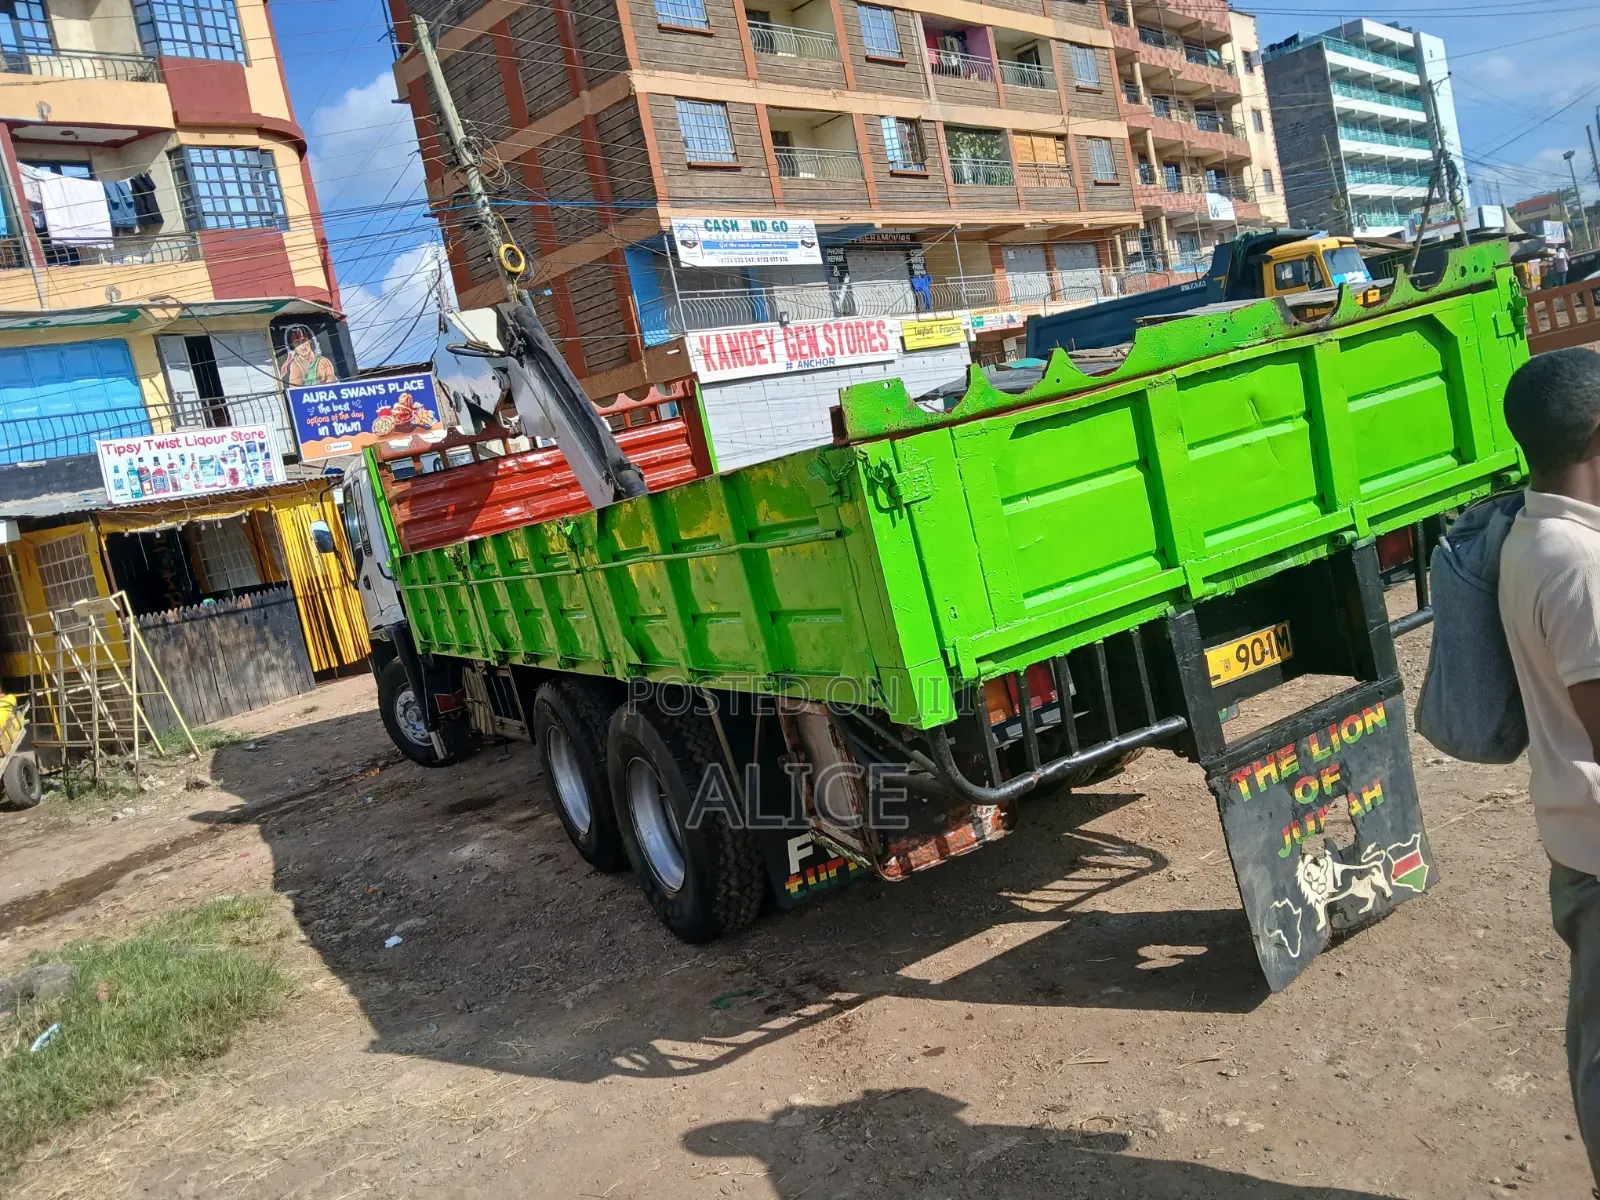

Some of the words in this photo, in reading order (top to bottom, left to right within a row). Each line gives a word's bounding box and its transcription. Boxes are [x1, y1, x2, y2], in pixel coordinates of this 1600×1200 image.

[771, 220, 789, 233] GO
[826, 255, 845, 263] REPAIR
[699, 328, 777, 372] KANDEY
[783, 319, 889, 362] GEN.STORES
[797, 358, 836, 370] ANCHOR
[302, 389, 337, 404] AURA
[340, 383, 386, 399] SWAN'S
[389, 379, 425, 394] PLACE
[306, 415, 330, 426] options
[331, 413, 339, 423] of
[339, 411, 350, 420] the
[351, 410, 365, 420] day
[317, 402, 331, 414] the
[332, 401, 350, 412] best
[318, 423, 329, 436] in
[102, 442, 142, 457] Tipsy
[144, 437, 182, 451] Twist
[185, 435, 227, 447] Liqour
[231, 429, 267, 442] Store
[1235, 626, 1291, 672] 901M
[1230, 743, 1300, 802] THE
[1309, 701, 1387, 763] LION
[1293, 763, 1341, 805] OF
[1278, 777, 1385, 858] JUAH
